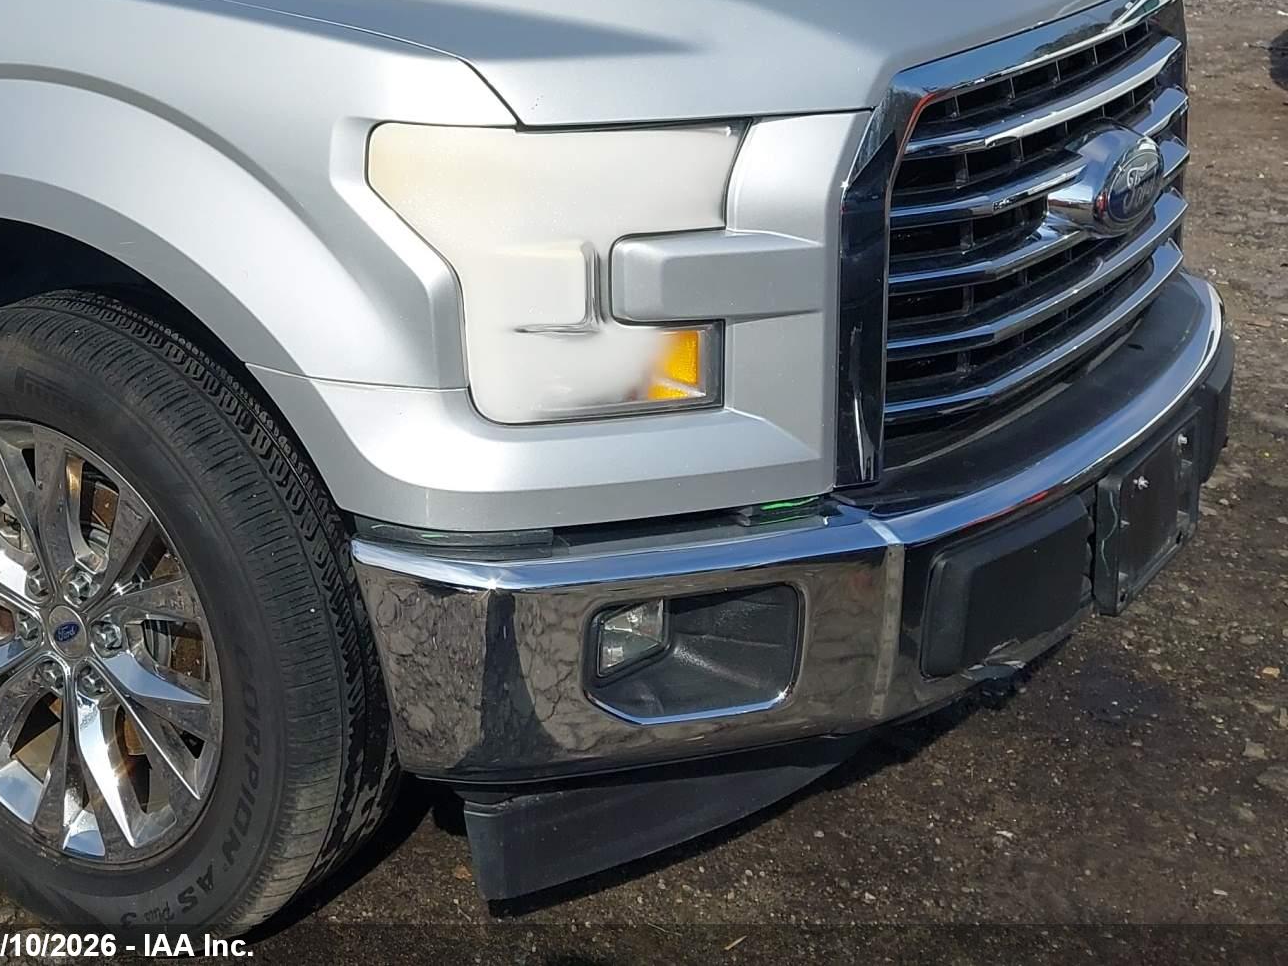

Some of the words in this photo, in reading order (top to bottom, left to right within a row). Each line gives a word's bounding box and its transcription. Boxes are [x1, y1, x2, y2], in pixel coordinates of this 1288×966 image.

[57, 625, 76, 641] Ford
[221, 626, 262, 866] CORPION
[176, 862, 214, 914] AS
